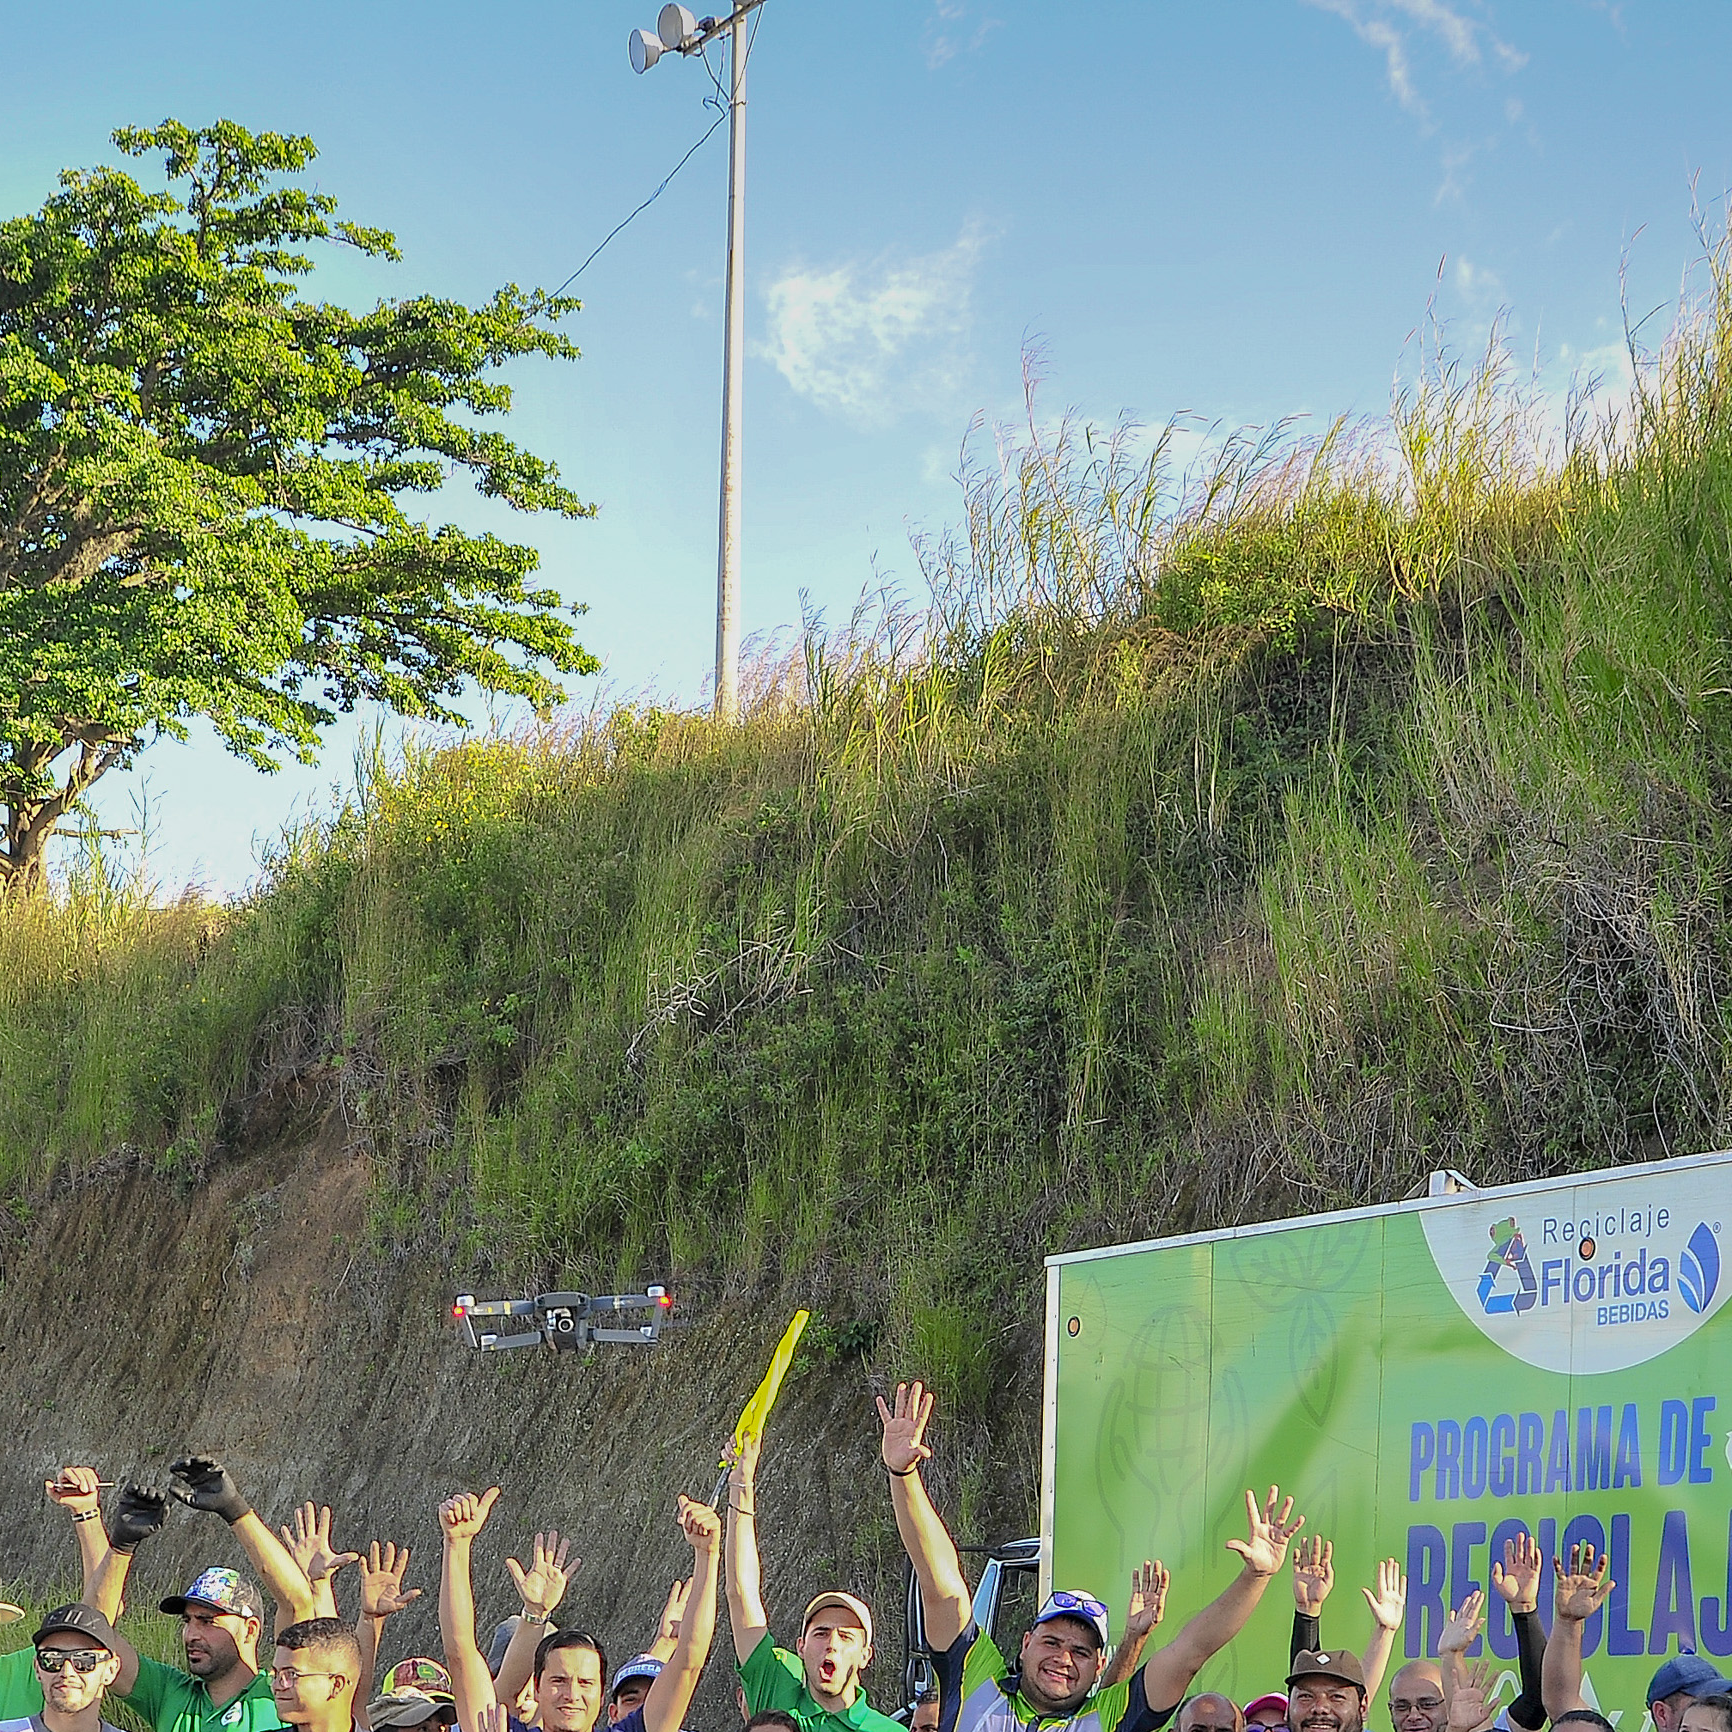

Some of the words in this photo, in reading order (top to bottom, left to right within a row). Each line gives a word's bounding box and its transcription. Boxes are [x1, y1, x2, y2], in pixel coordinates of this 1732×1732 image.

[1543, 1203, 1669, 1244] Reciclaje
[1541, 1247, 1669, 1307] Florida
[1597, 1299, 1669, 1326] BEBIDAS
[1408, 1403, 1642, 1502] PROGRAMA
[1657, 1396, 1717, 1487] DE
